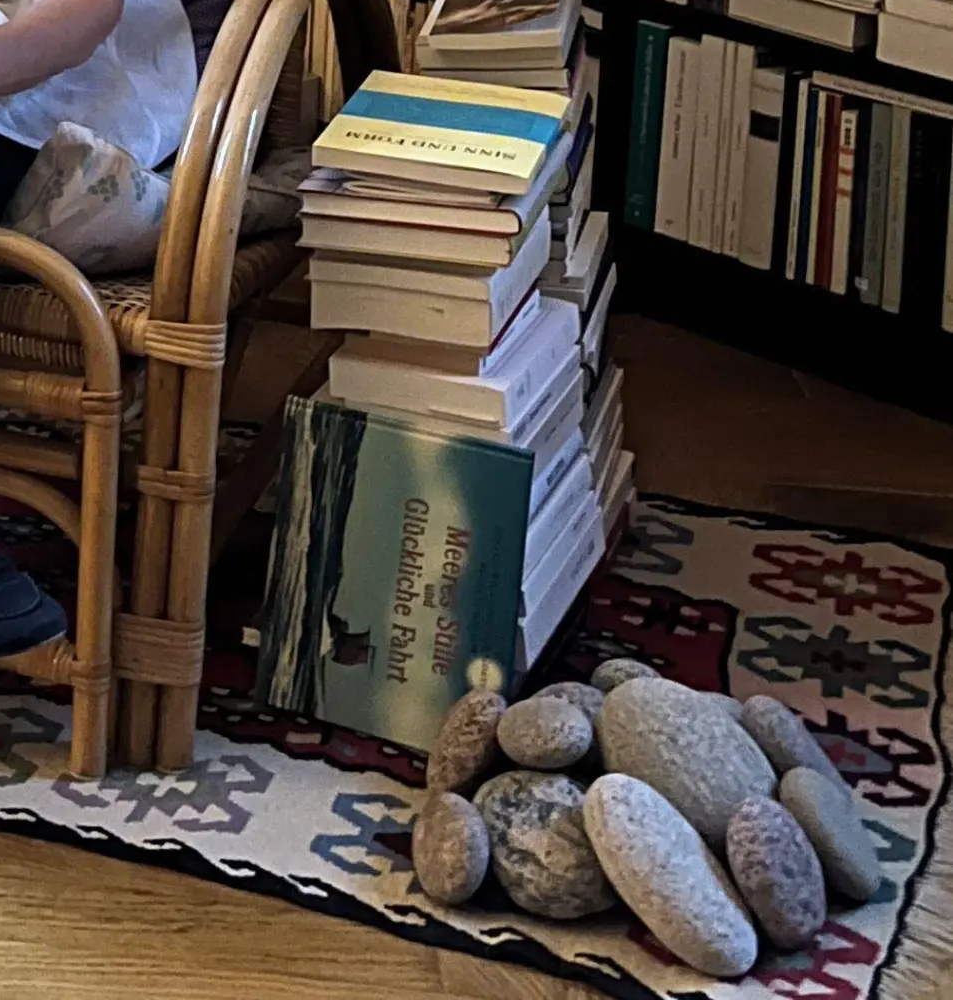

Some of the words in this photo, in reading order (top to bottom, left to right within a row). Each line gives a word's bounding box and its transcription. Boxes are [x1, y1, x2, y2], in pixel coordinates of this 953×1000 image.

[345, 130, 405, 146] FORM
[412, 139, 457, 153] UND
[463, 144, 517, 161] SINN
[393, 498, 430, 616] Glückliche
[438, 525, 471, 607] Meeres
[422, 584, 436, 608] und
[386, 624, 416, 684] Fahrt
[431, 615, 462, 676] Stille
